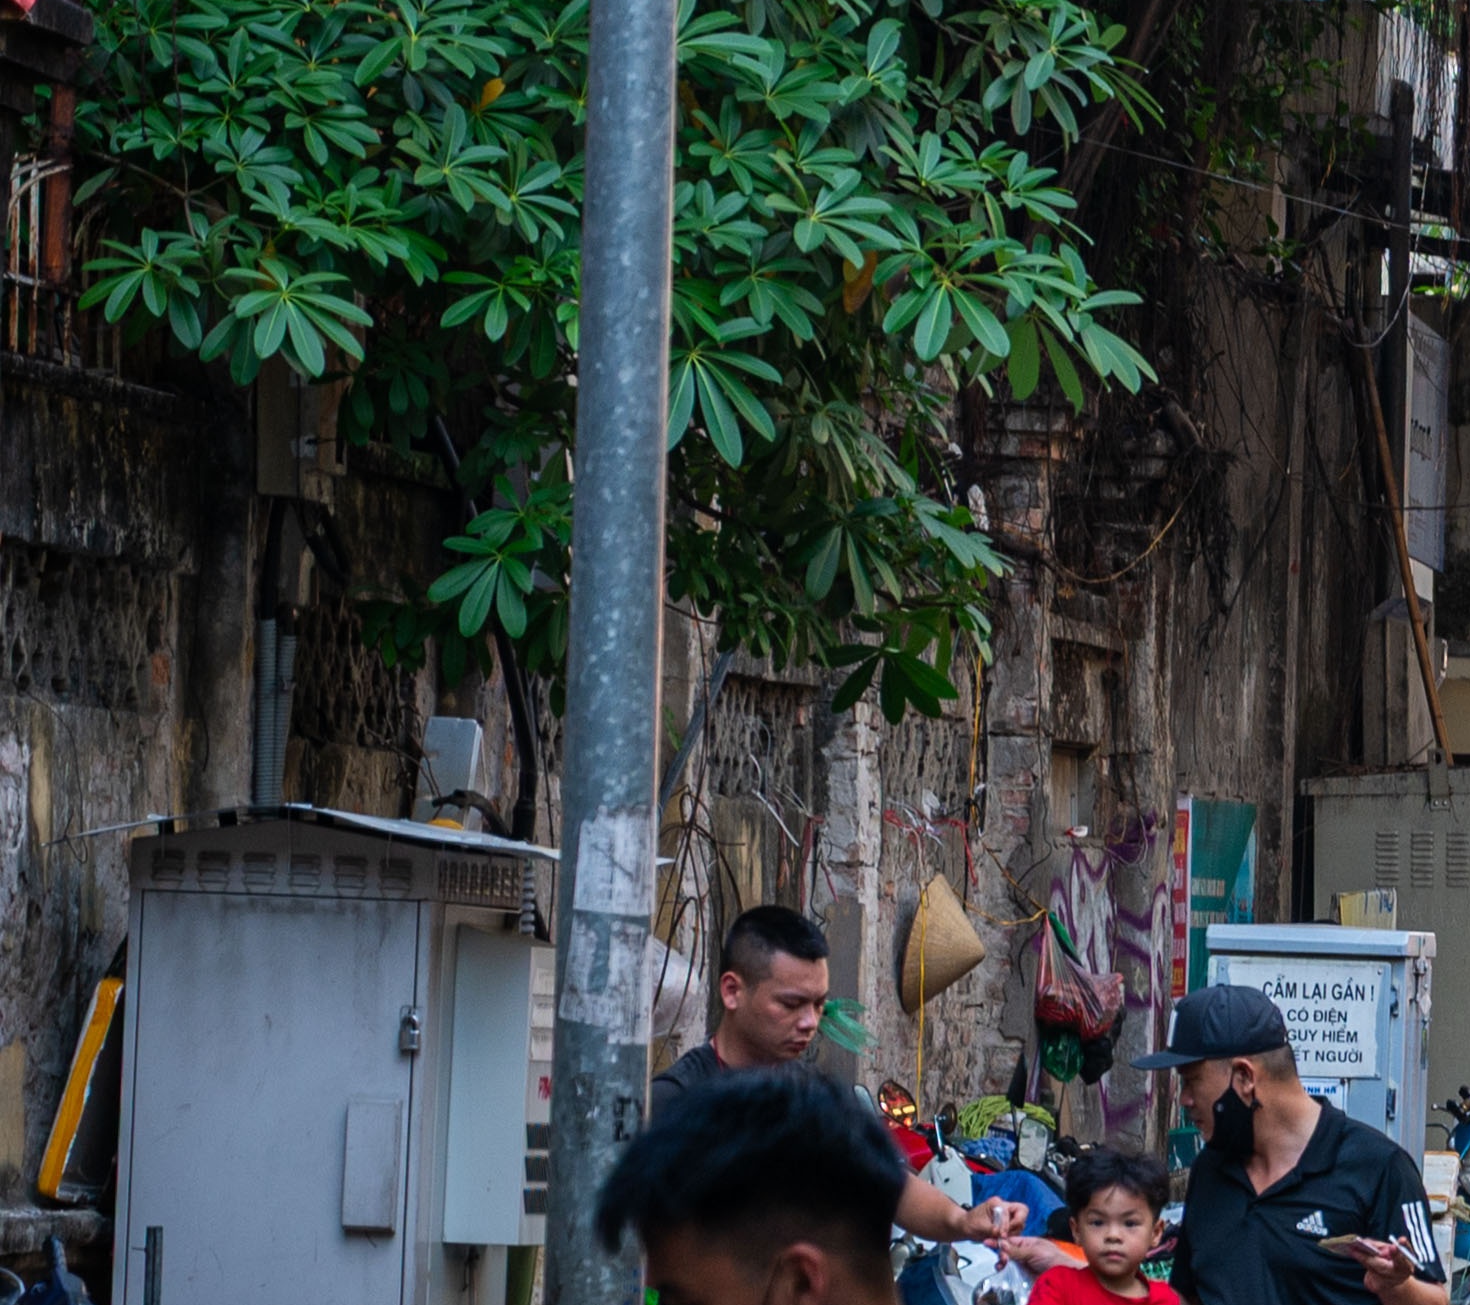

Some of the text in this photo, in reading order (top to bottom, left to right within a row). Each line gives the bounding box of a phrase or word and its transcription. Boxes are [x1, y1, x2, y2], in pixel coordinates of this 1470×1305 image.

[1302, 983, 1326, 1004] LẠI
[1331, 978, 1365, 1001] GẦN
[1287, 1007, 1348, 1026] CÓ ĐIỆN
[1287, 1024, 1358, 1044] GUY HIỂM
[1315, 1047, 1363, 1063] NGƯỜI
